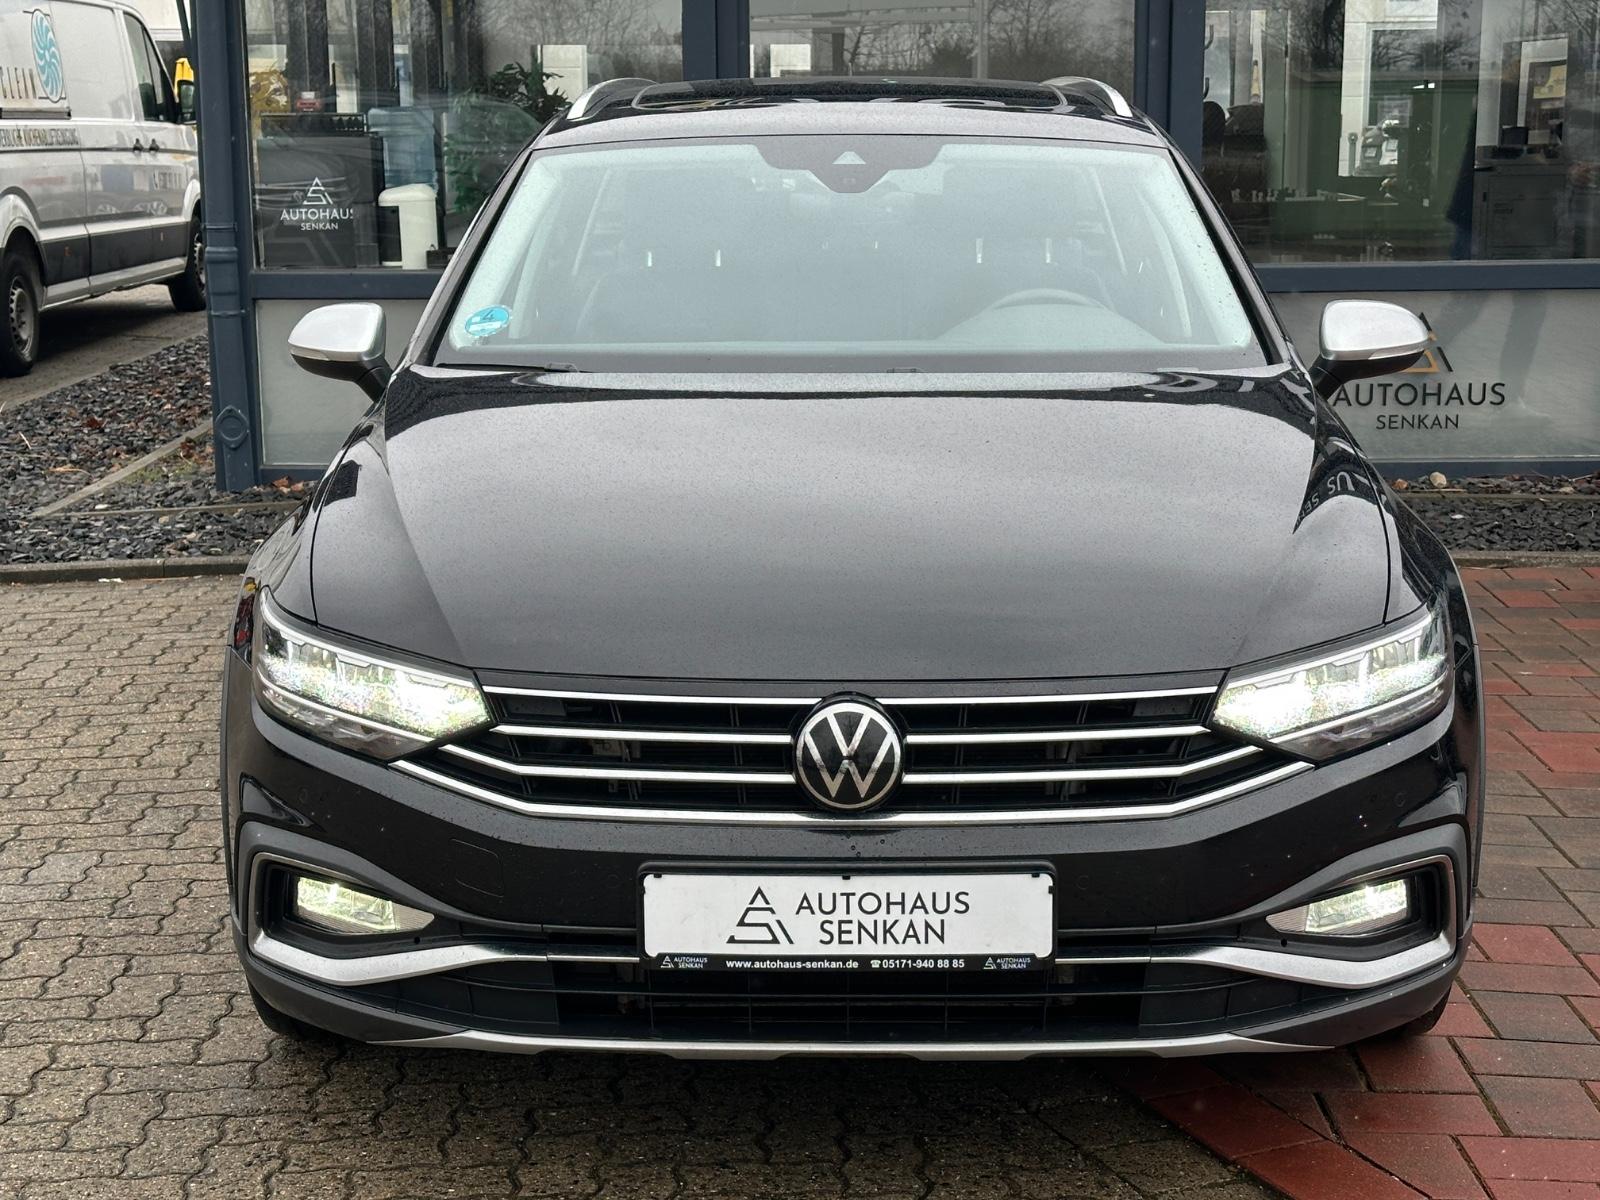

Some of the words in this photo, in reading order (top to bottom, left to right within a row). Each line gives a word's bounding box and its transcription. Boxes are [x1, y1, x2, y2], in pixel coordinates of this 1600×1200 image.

[300, 222, 338, 231] SENKAN
[1333, 382, 1506, 407] AUTOHAUS
[1376, 414, 1459, 430] SENKAN
[795, 891, 970, 916] AUTOHAUS
[819, 919, 945, 945] SENKAN
[726, 959, 859, 969] www.autohaus-senkan.de
[882, 959, 934, 969] 05171-940
[937, 959, 950, 969] 88
[952, 959, 965, 969] 85
